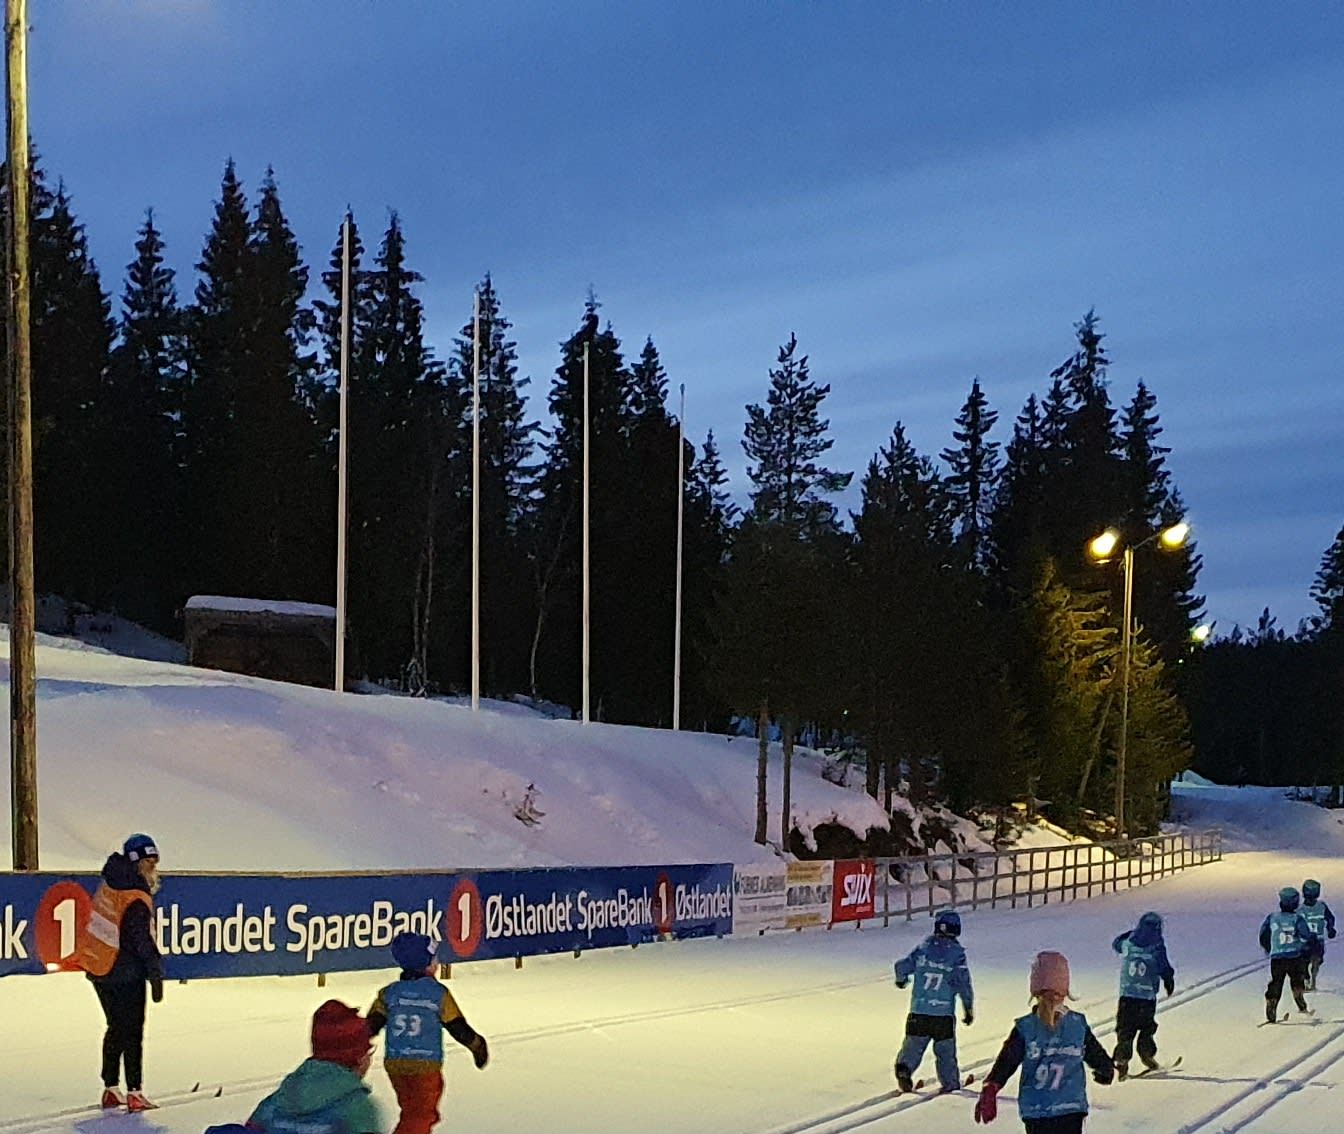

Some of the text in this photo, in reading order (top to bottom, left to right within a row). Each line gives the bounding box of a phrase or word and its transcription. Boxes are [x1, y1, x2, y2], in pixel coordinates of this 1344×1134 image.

[53, 899, 75, 960] 1
[458, 893, 470, 942] 1
[485, 891, 573, 940] Østlandet
[577, 887, 653, 938] SpareBank
[675, 883, 732, 922] Østlandet
[923, 972, 944, 992] 77
[392, 1013, 422, 1037] 53
[1034, 1062, 1065, 1091] 97
